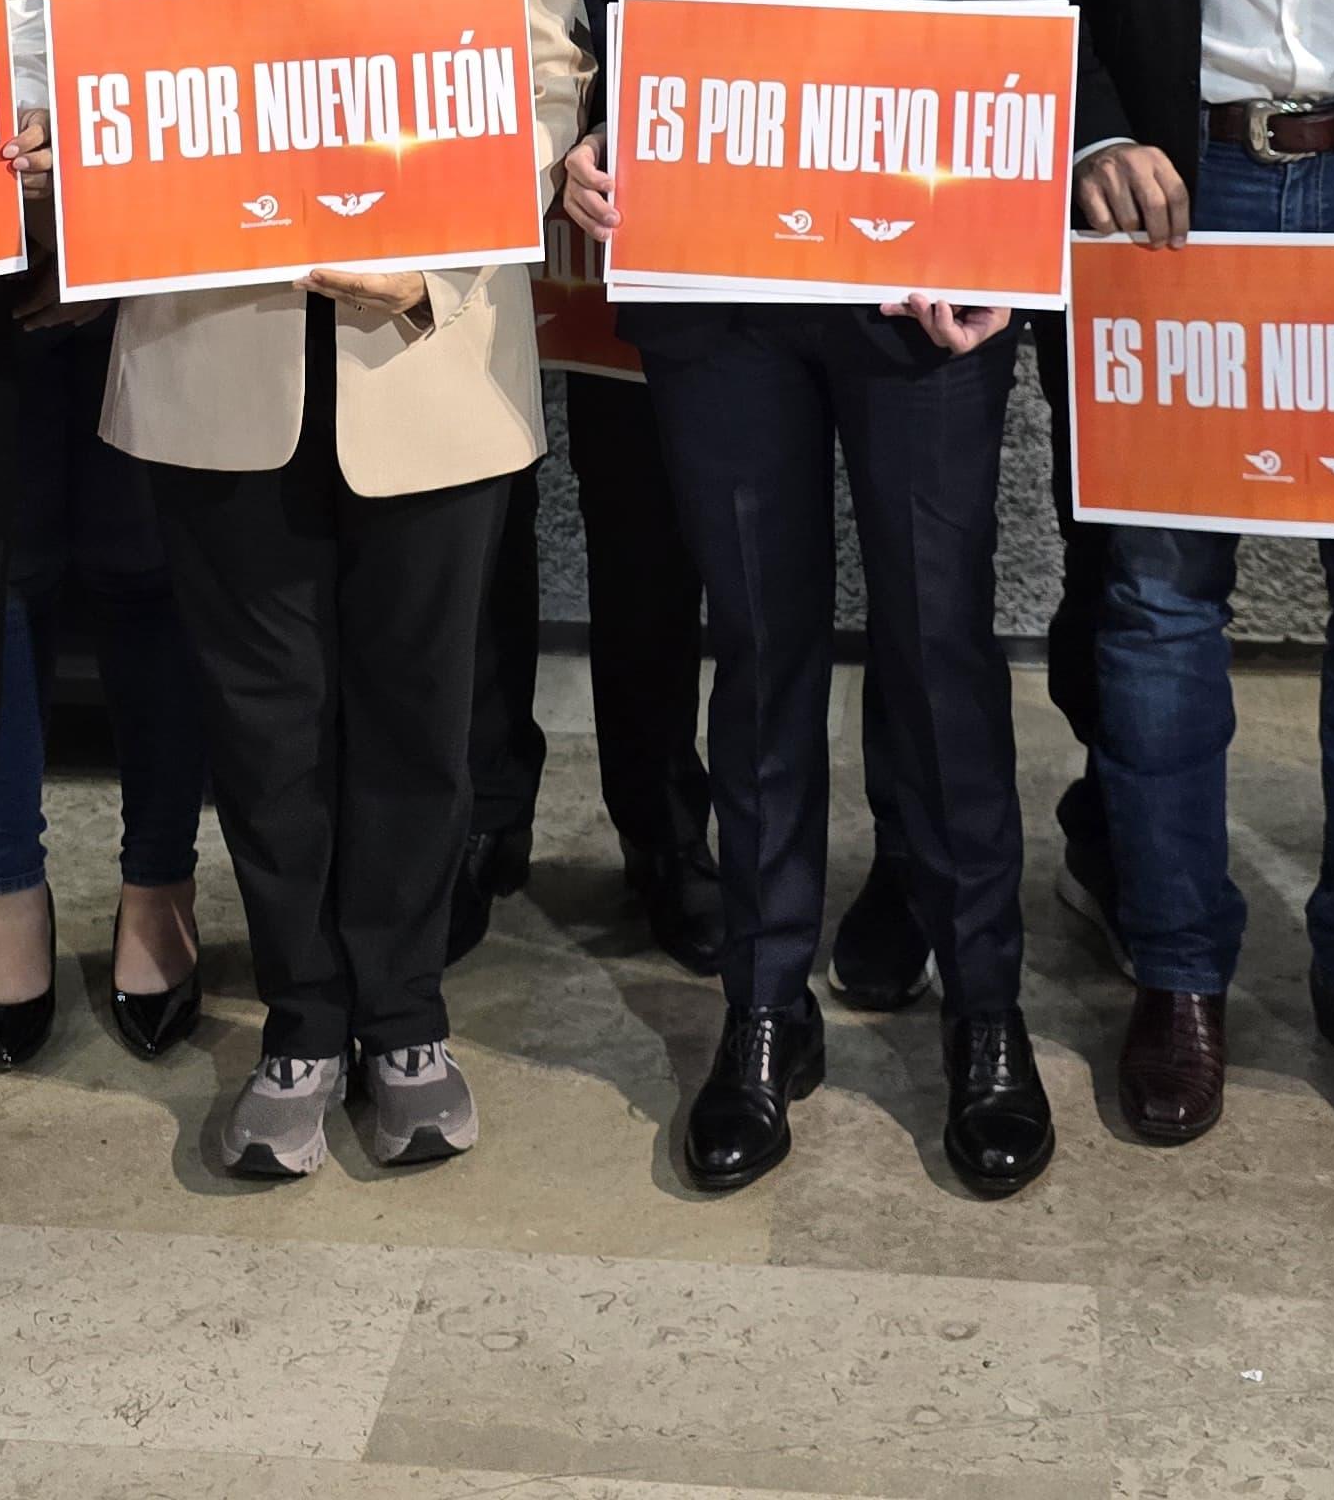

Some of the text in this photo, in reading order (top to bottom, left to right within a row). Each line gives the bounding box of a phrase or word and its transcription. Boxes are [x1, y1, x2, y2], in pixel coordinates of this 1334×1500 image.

[77, 30, 517, 167] ES POR NUEVO LEÓN
[636, 74, 1056, 181] ES POR NUEVO LEÓN
[1093, 317, 1143, 404] ES
[1155, 320, 1247, 409] POR
